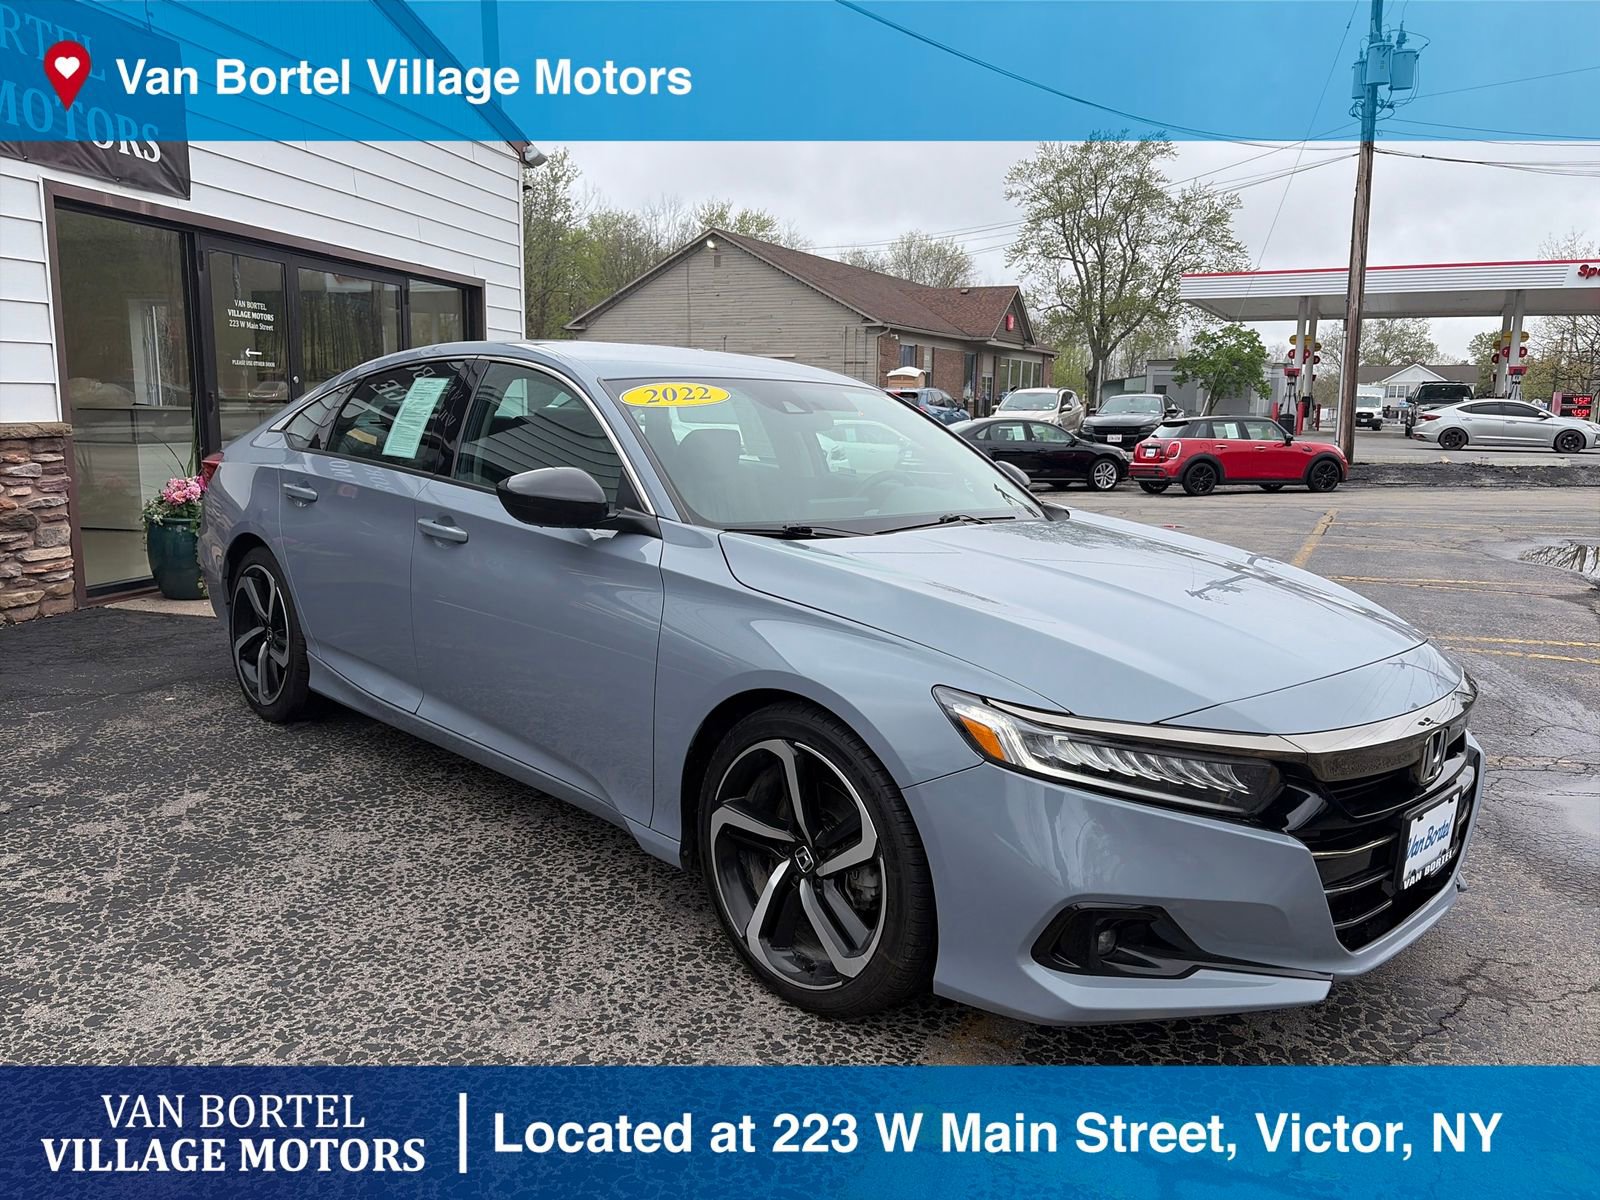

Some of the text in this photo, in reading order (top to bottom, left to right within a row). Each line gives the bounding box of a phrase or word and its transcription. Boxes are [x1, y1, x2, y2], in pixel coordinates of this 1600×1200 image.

[0, 3, 106, 82] RTL
[234, 299, 267, 310] VAN BORTEL
[227, 309, 274, 321] VILLAGE MOTORS
[240, 320, 246, 328] W
[246, 321, 259, 330] Main
[259, 323, 274, 331] Street
[643, 386, 712, 404] 2022
[1403, 871, 1422, 889] VAN
